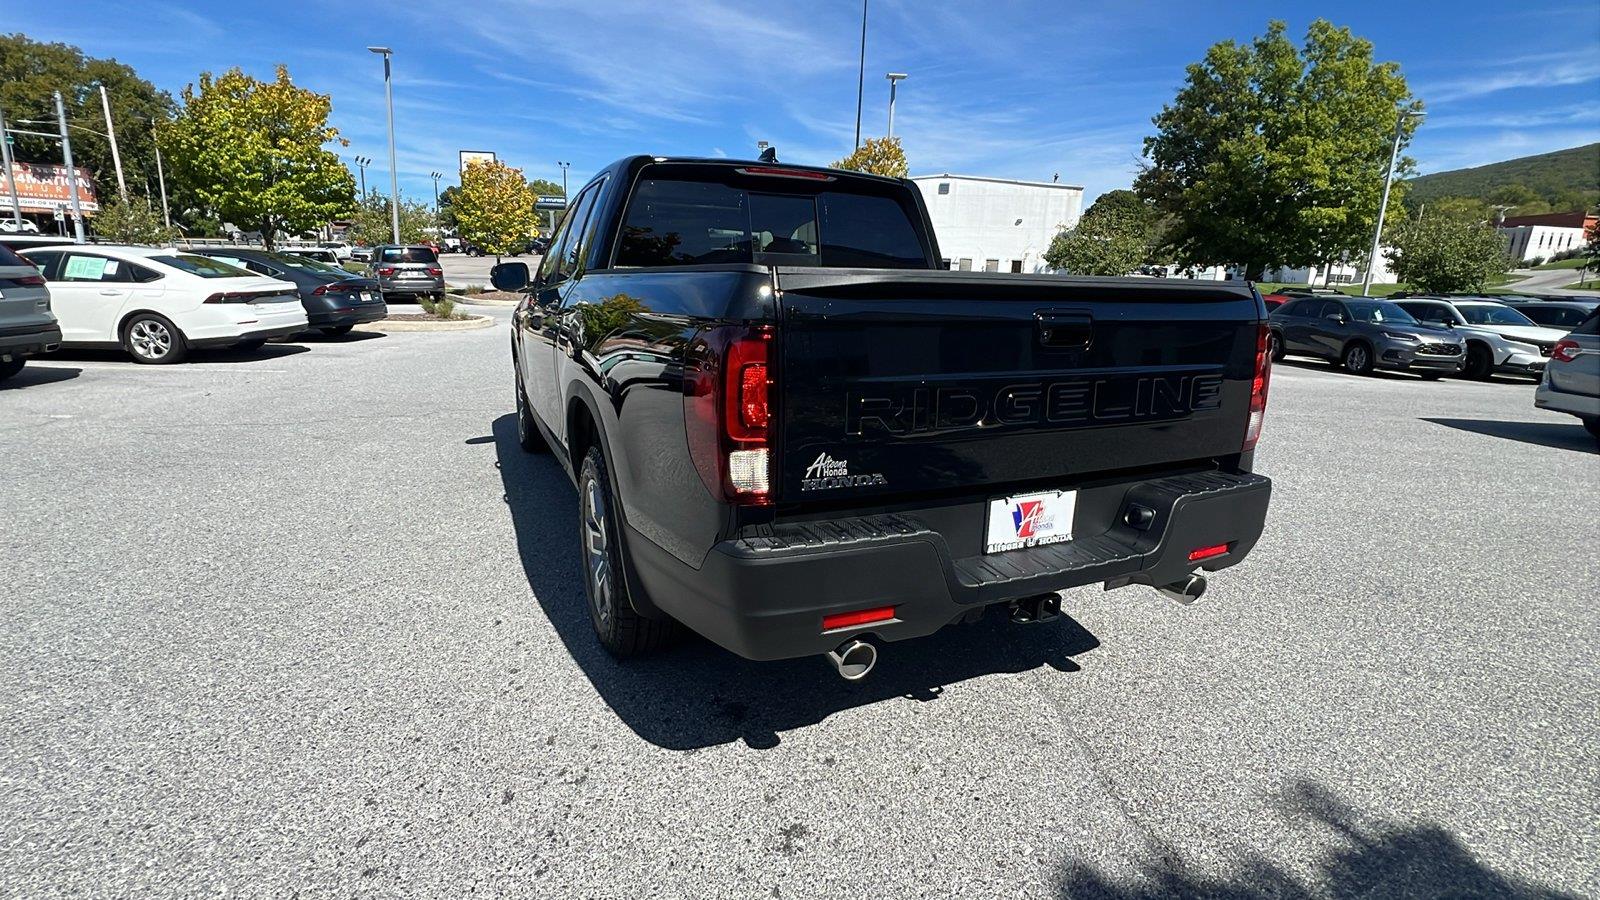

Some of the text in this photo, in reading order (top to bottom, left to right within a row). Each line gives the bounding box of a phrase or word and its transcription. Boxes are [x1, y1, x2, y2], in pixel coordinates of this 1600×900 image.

[846, 373, 1223, 436] RIDGELINE
[806, 452, 848, 478] Altoona
[823, 468, 848, 477] Honda
[801, 473, 888, 491] HONDA
[987, 534, 1073, 554] Altoona HONDA
